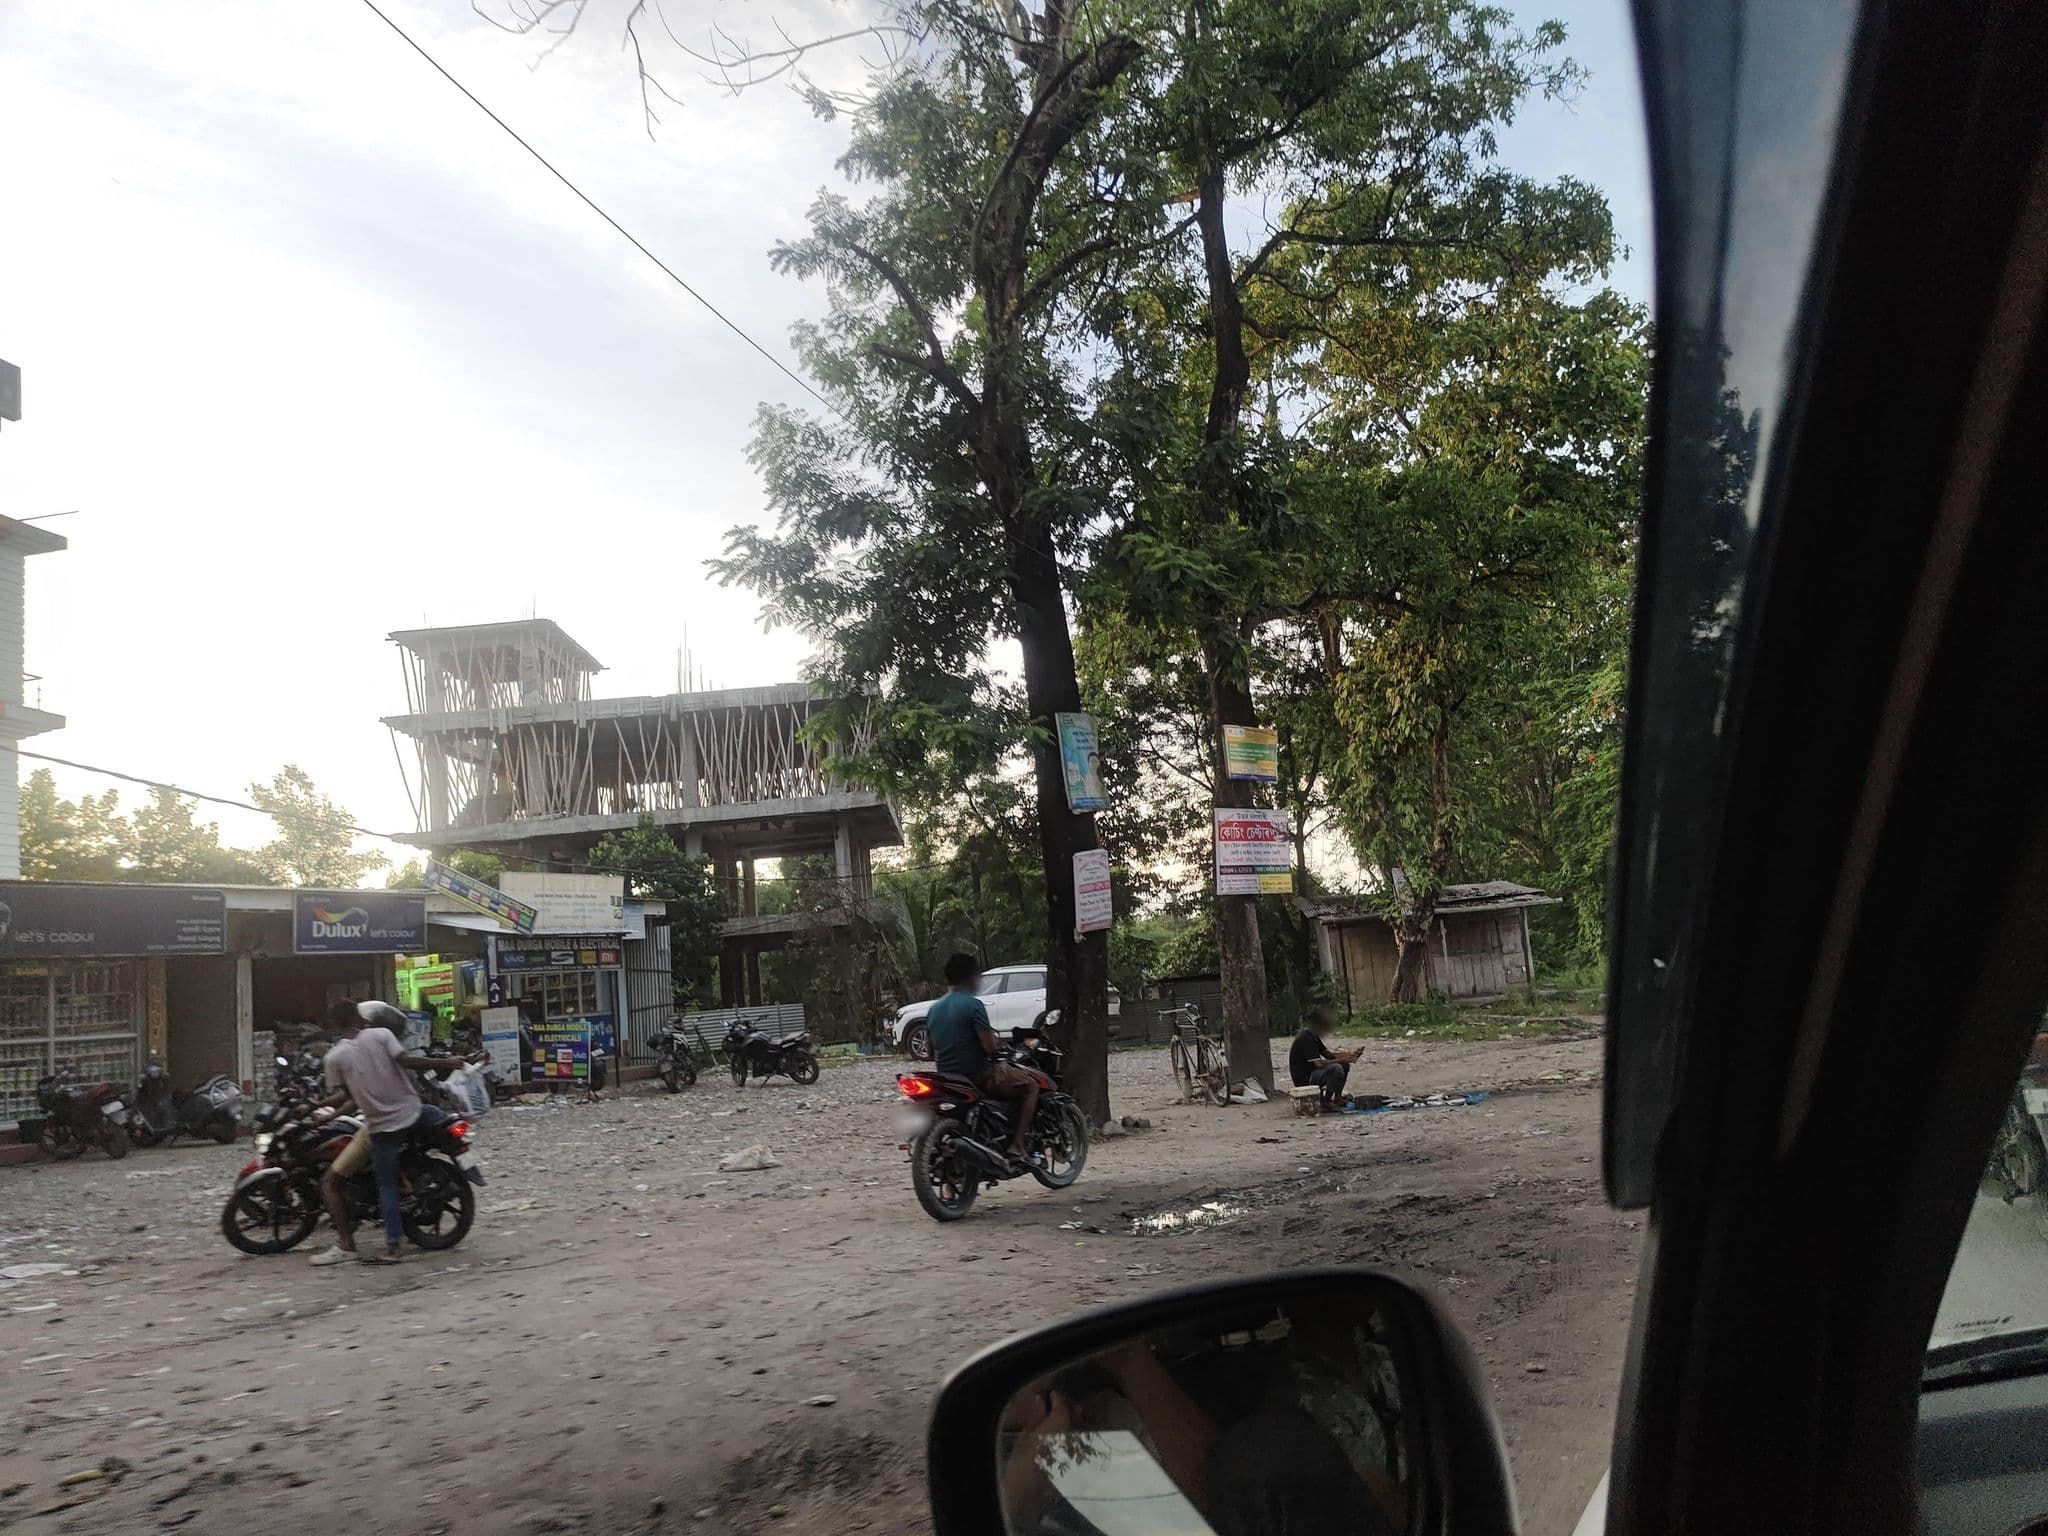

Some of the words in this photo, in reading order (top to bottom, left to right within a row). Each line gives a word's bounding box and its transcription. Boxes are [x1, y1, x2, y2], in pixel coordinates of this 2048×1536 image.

[312, 921, 362, 938] Dulux
[517, 939, 543, 951] DURGA
[544, 938, 572, 950] MOBILE
[573, 938, 579, 950] &
[546, 1023, 566, 1031] DURGA
[567, 1023, 587, 1031] MOBILE
